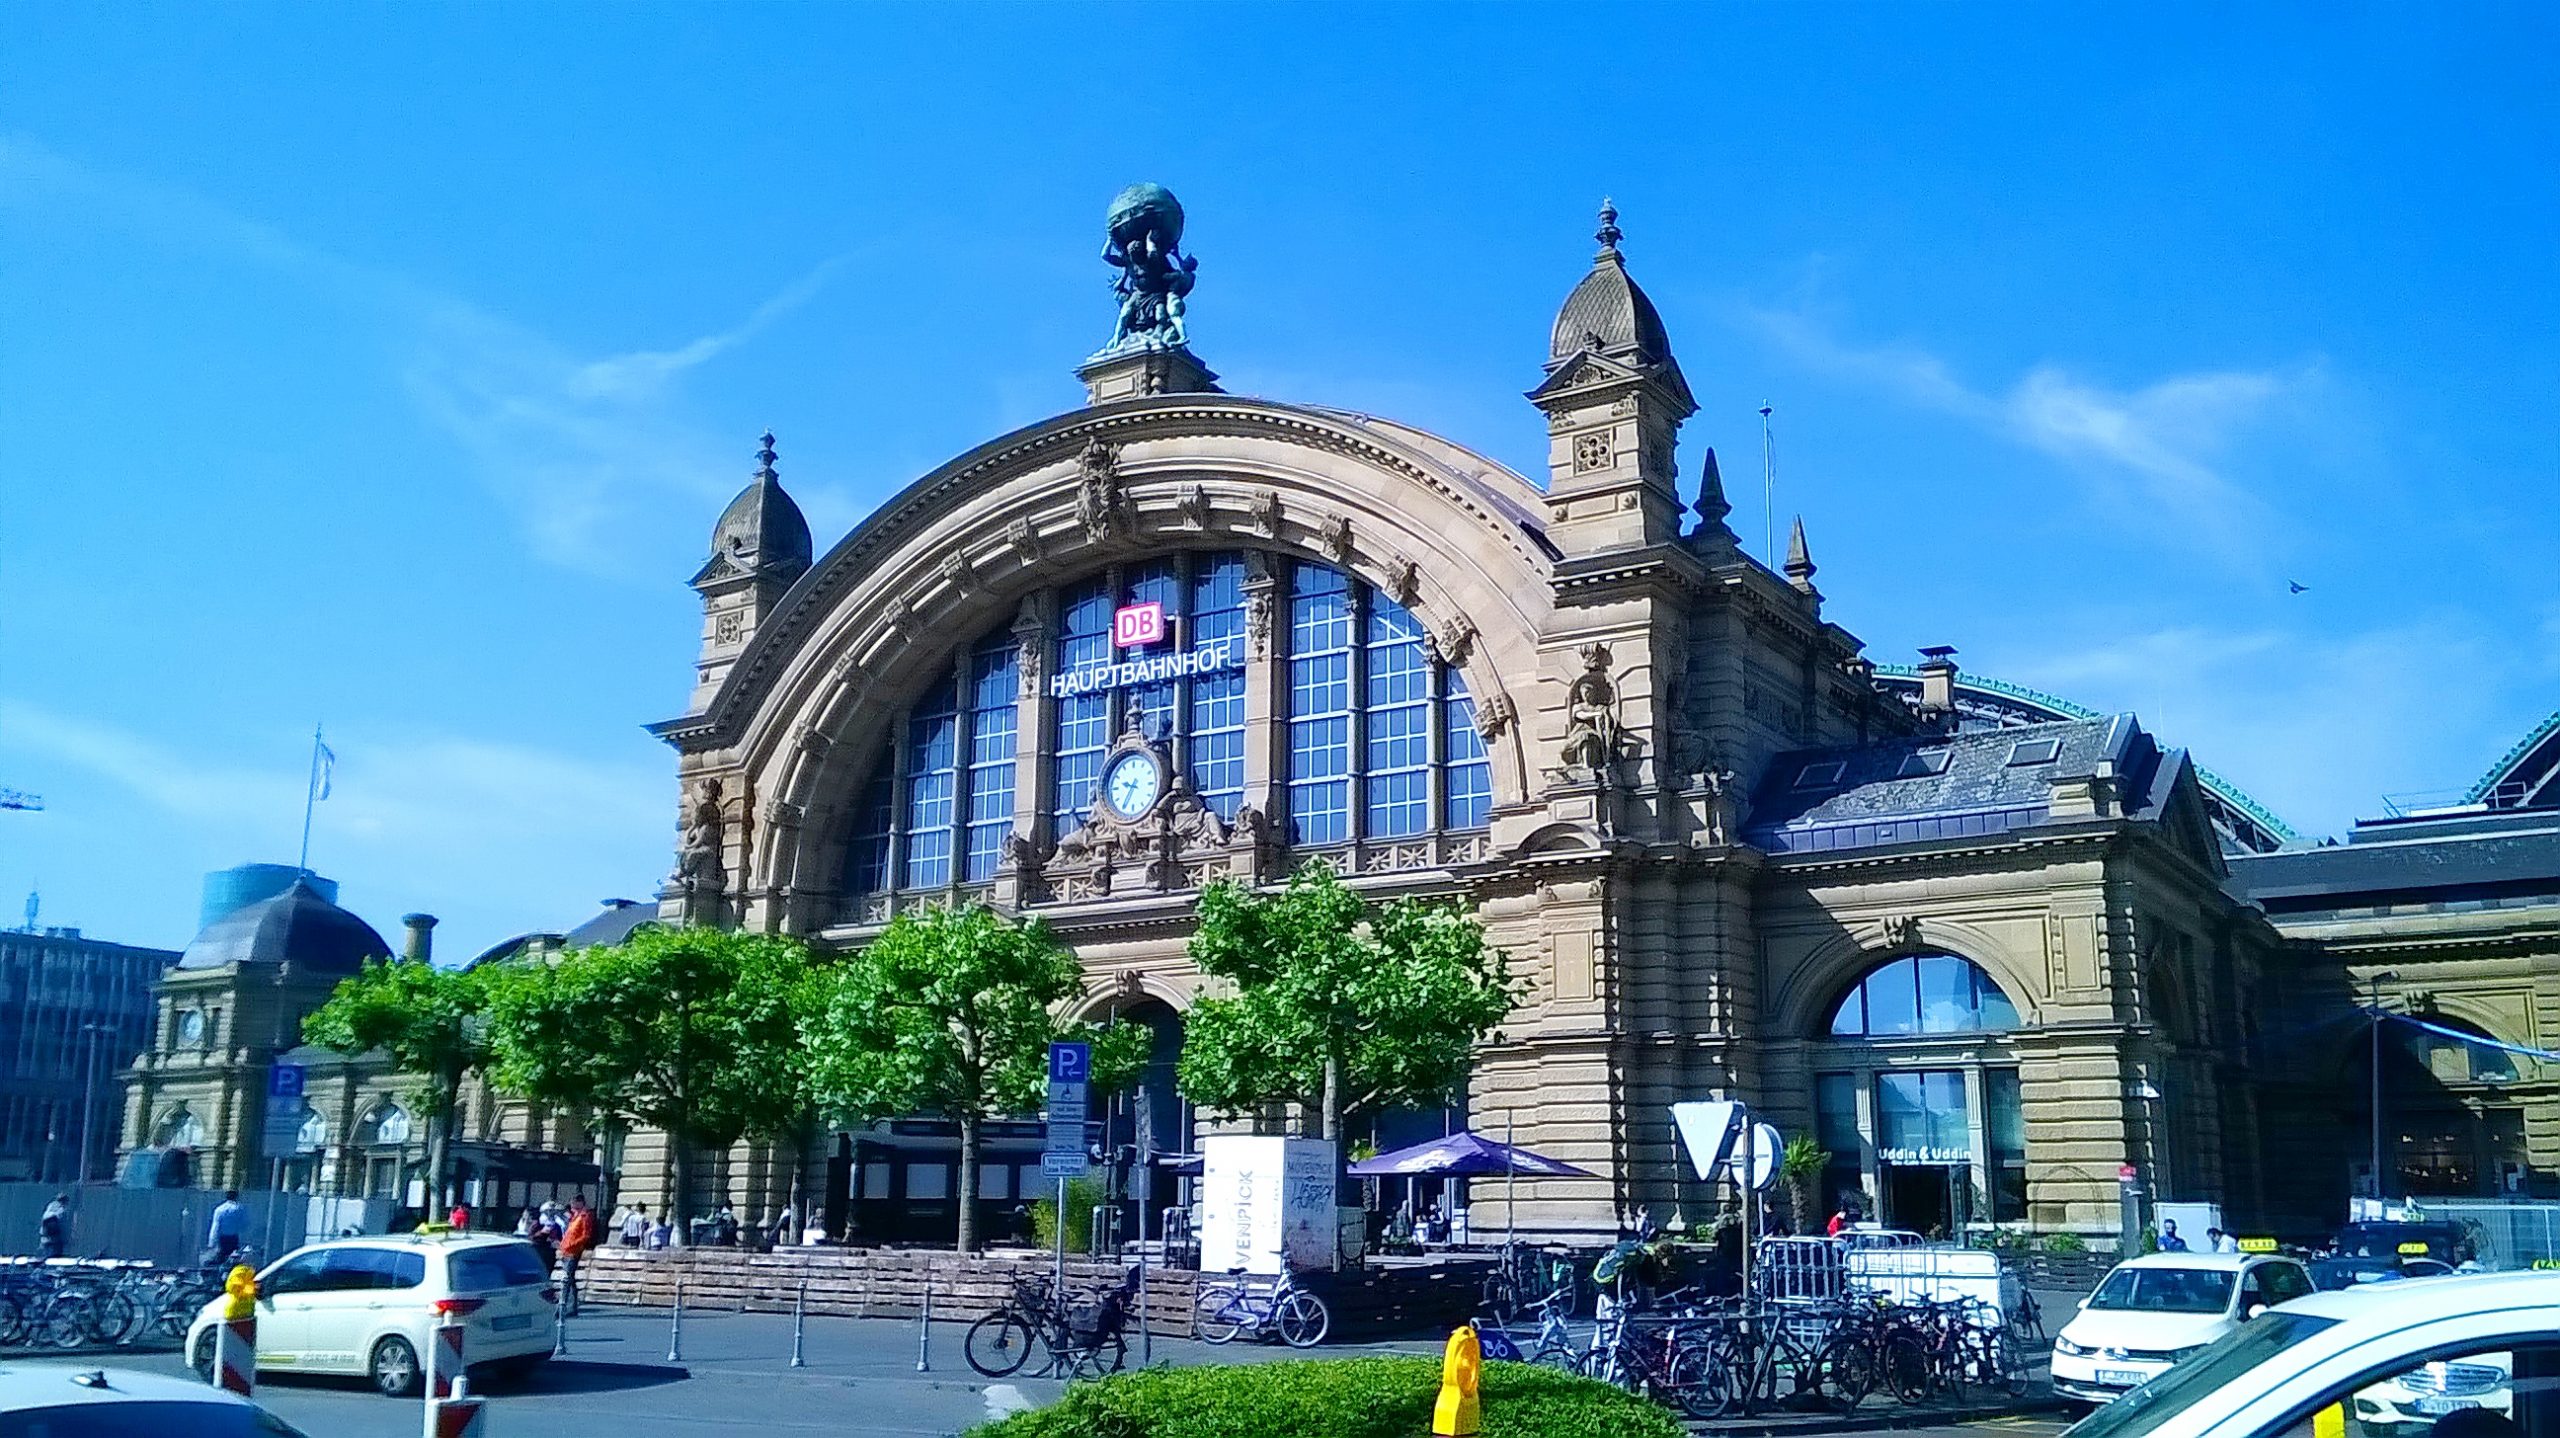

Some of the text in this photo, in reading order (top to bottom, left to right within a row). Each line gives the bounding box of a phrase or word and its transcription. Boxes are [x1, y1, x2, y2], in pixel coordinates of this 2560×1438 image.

[1121, 610, 1154, 639] DB
[1050, 648, 1231, 697] HAUPTBAHNHOF
[1057, 1048, 1078, 1077] P
[1878, 1145, 1972, 1160] Uddin & Uddin
